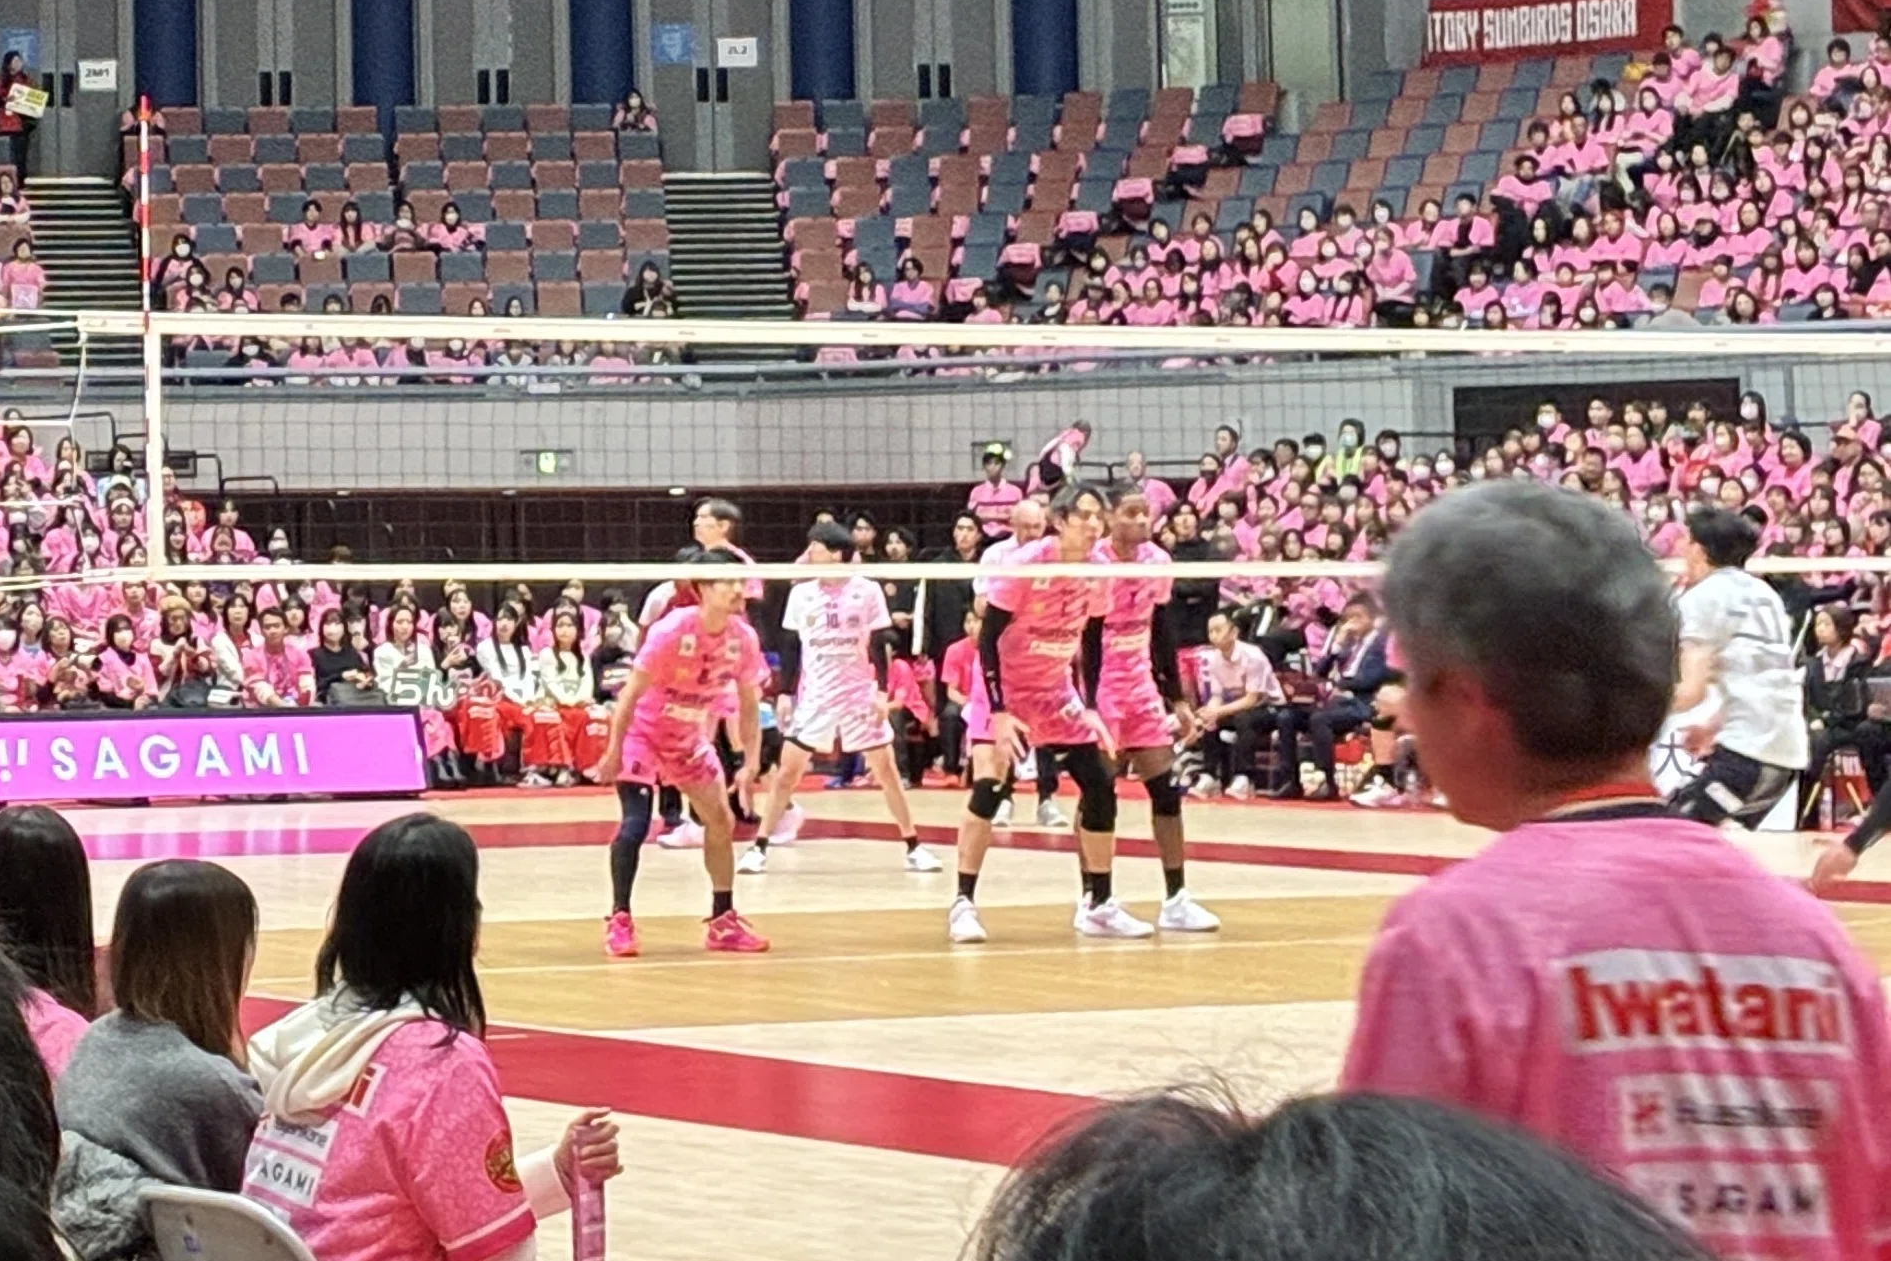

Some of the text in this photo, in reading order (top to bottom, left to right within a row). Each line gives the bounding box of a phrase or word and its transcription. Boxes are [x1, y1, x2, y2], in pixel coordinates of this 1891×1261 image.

[1482, 1, 1573, 50] SUNBIRDS
[394, 671, 455, 707] らん
[49, 731, 311, 781] SAGAMI
[1568, 965, 1845, 1042] Iwatani
[259, 1157, 315, 1196] AGAMI
